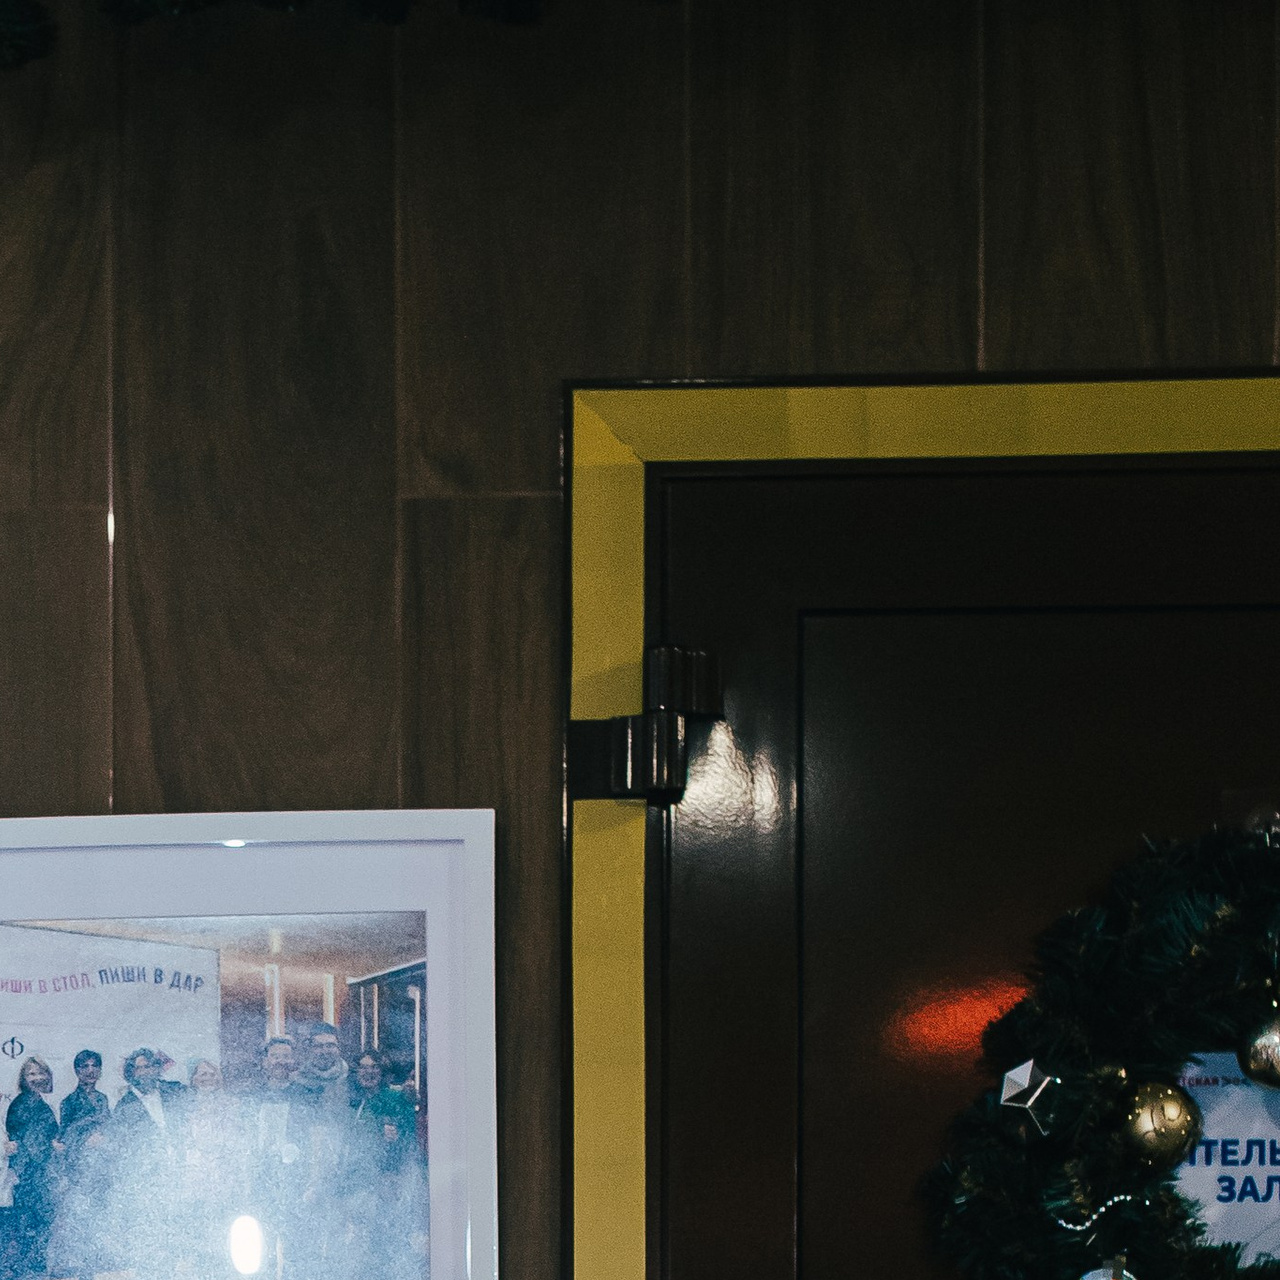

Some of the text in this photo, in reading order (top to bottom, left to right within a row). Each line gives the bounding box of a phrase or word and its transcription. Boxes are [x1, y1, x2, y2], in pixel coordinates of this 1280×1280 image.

[38, 979, 49, 994] В
[98, 966, 147, 986] ПИШИ
[154, 967, 165, 985] В
[169, 970, 205, 994] ДАР
